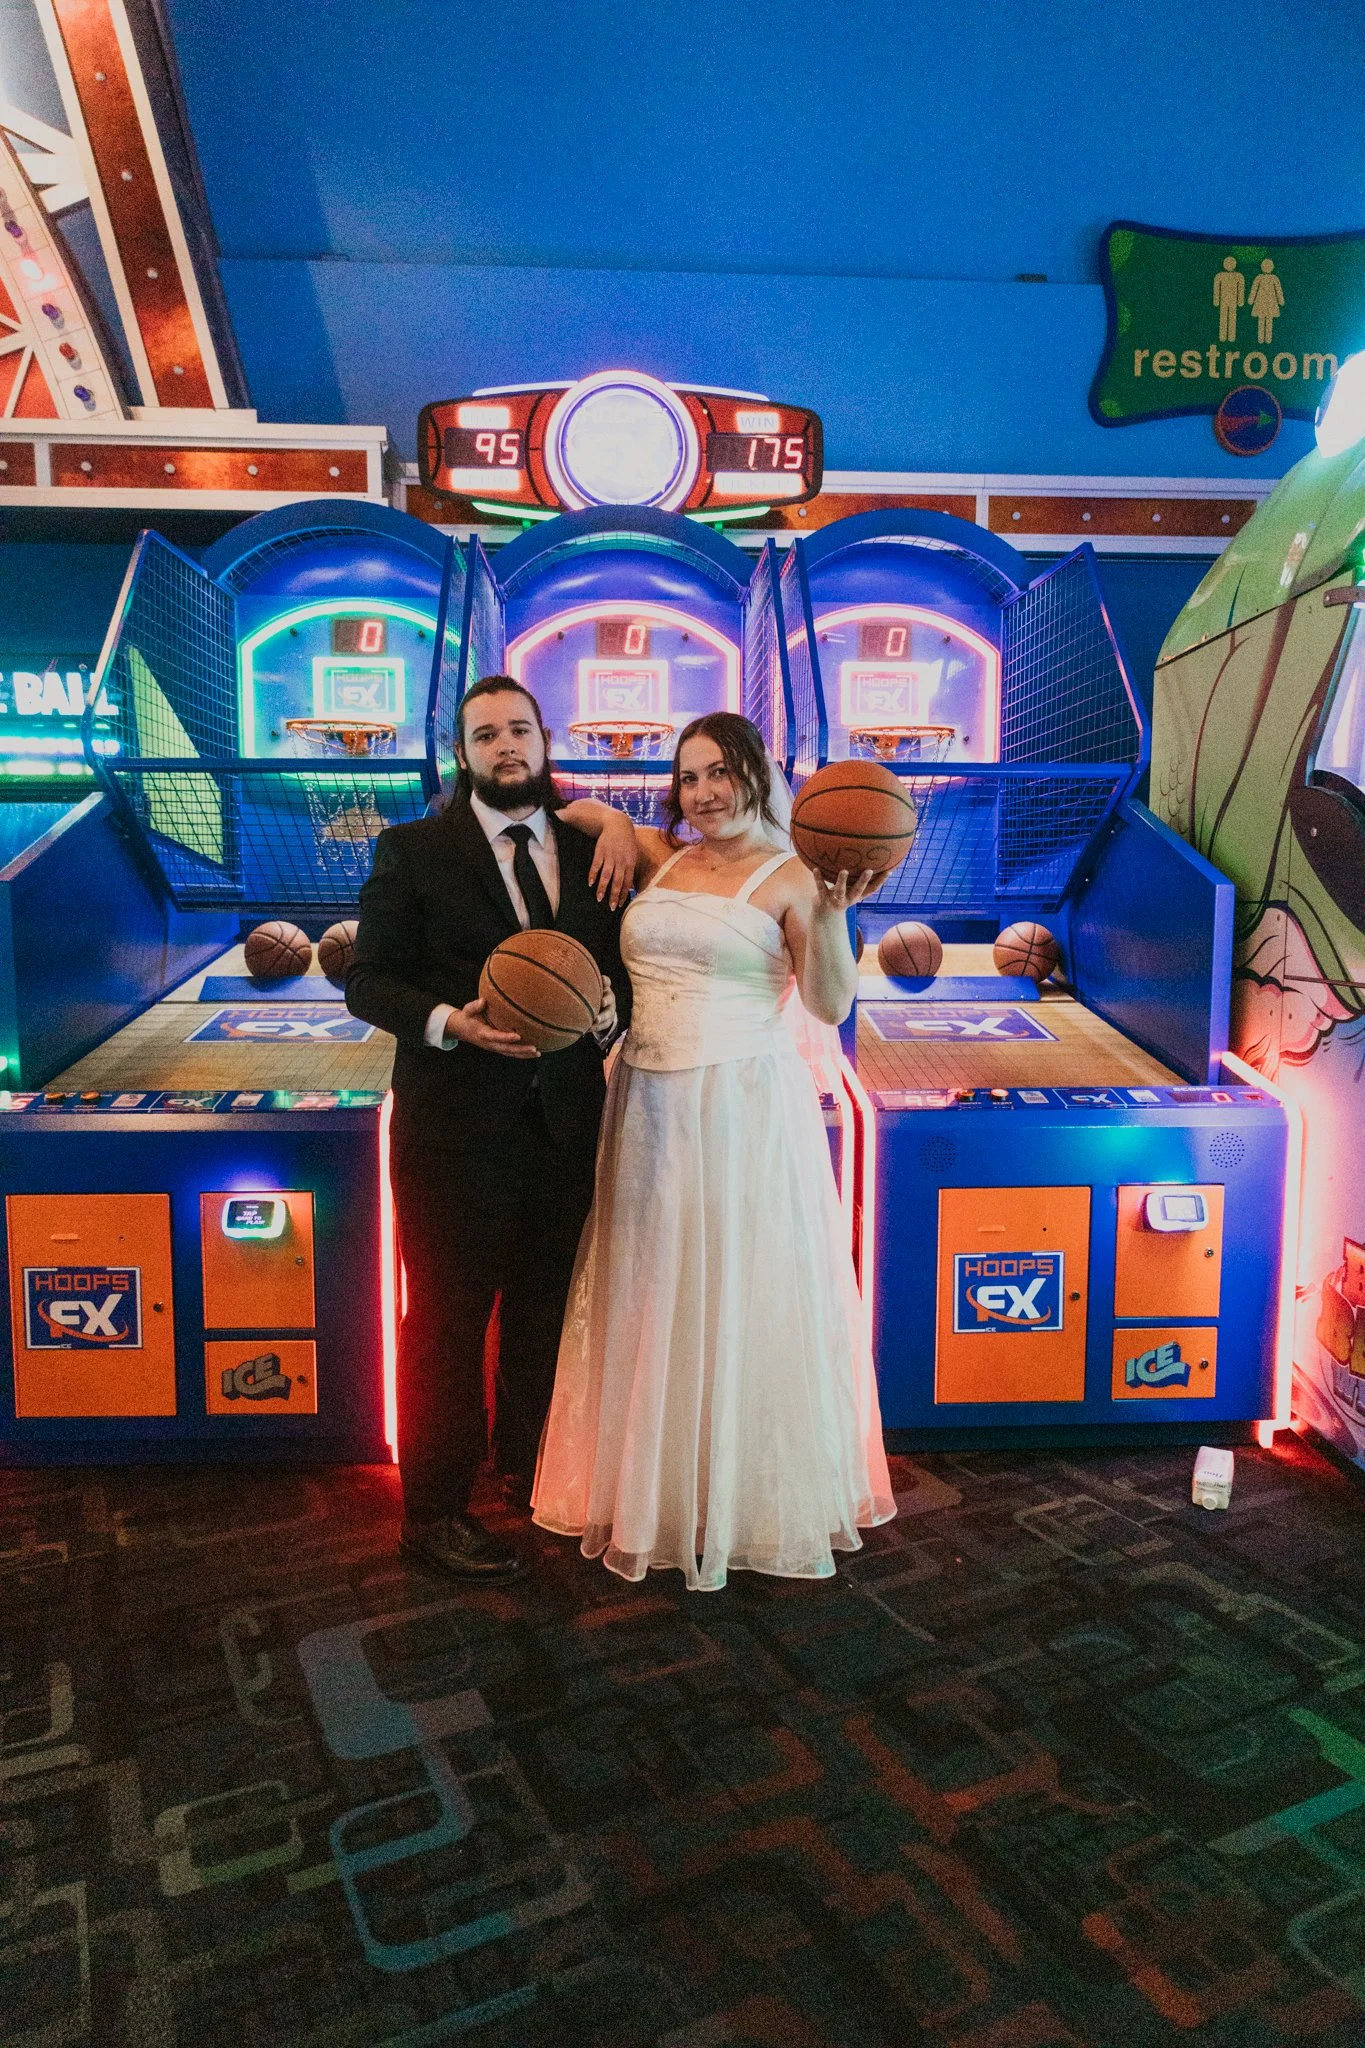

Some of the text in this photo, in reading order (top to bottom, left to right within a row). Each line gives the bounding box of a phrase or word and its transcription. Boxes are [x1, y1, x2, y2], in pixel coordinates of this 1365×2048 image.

[1133, 344, 1338, 381] restroom
[475, 432, 520, 465] 95
[748, 438, 804, 469] 175
[360, 621, 383, 653] 0
[624, 625, 647, 654] 0
[885, 627, 907, 657] 0
[1211, 1092, 1233, 1103] 0
[35, 1273, 130, 1292] HOOPS
[965, 1258, 1054, 1278] HOOPS
[222, 1352, 291, 1400] ICE
[1125, 1341, 1191, 1388] ICE
